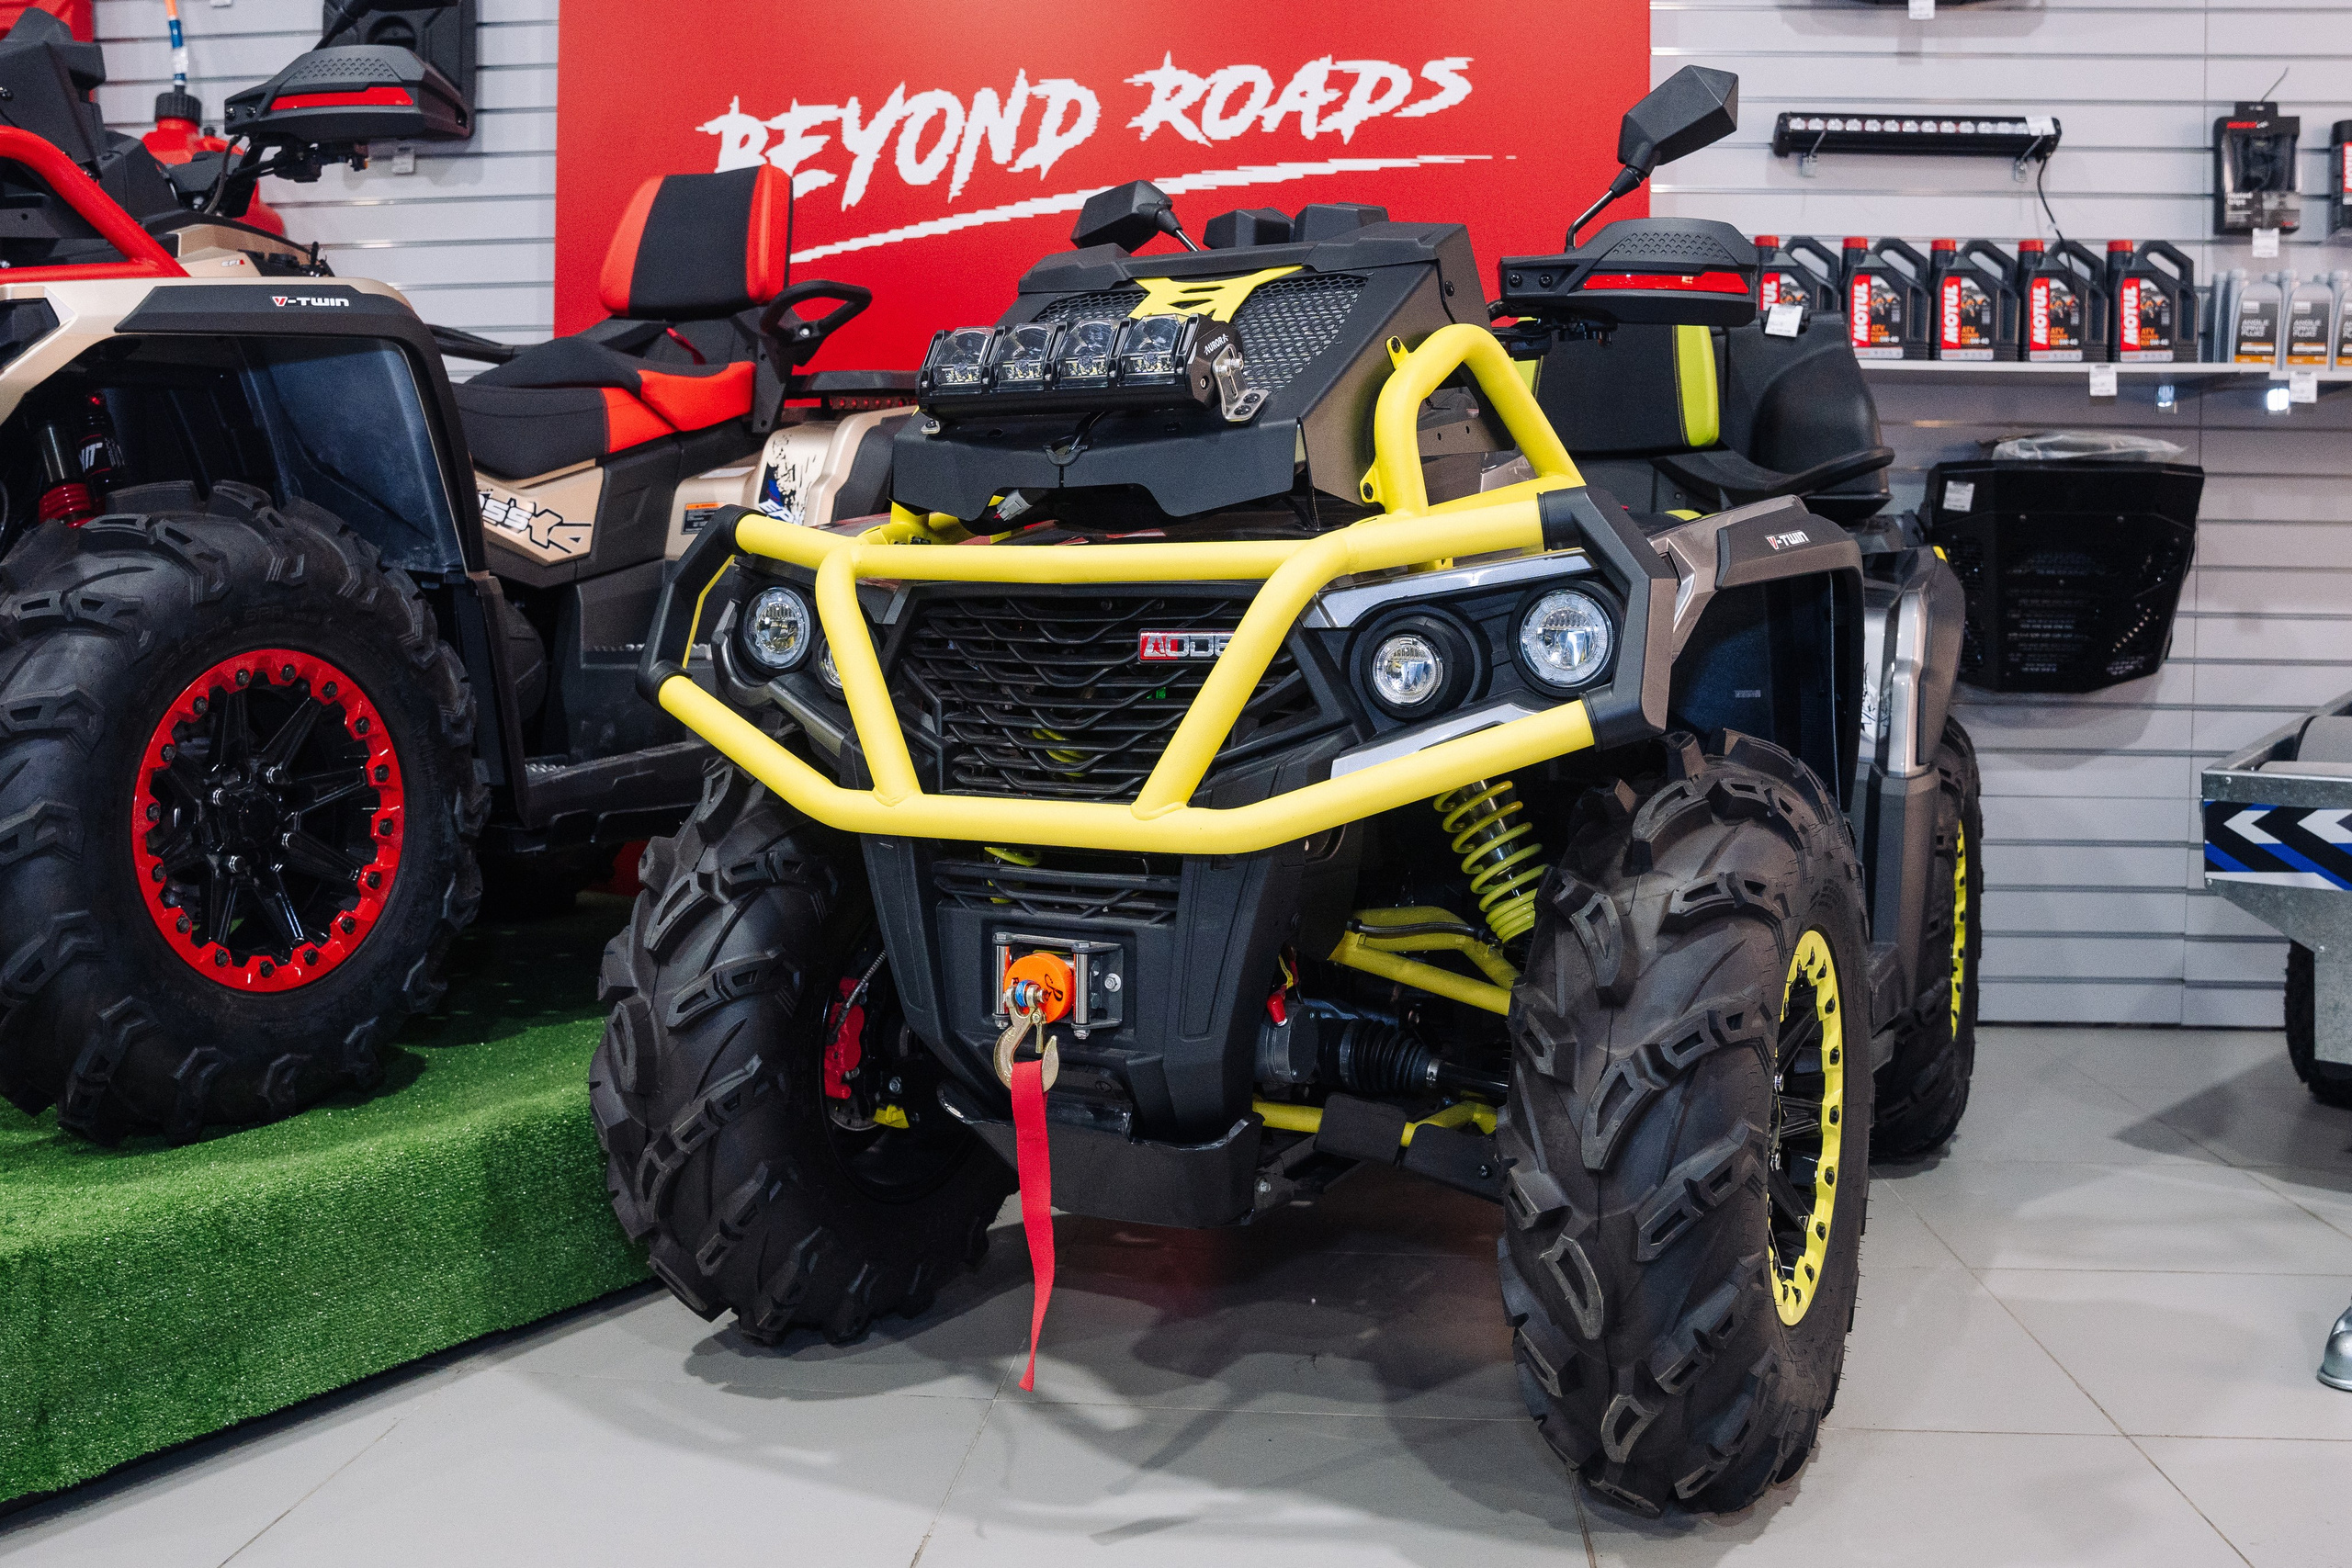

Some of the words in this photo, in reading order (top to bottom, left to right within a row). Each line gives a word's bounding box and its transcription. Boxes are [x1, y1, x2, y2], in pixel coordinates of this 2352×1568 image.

[695, 68, 1101, 210] BEYOND
[1125, 51, 1474, 147] ROADS
[272, 296, 350, 307] V-TWIN
[1763, 281, 1778, 310] TUL
[1854, 283, 1869, 342] MOTUL
[1944, 285, 1959, 344] MOTUL
[2033, 286, 2047, 344] MOTUL
[2123, 286, 2138, 345] MOTUL
[2243, 319, 2270, 327] ANGLE
[2294, 319, 2322, 327] ANGLE
[1204, 333, 1229, 355] AURORA
[1766, 531, 1810, 550] V-TWIN
[1143, 635, 1235, 657] AODE
